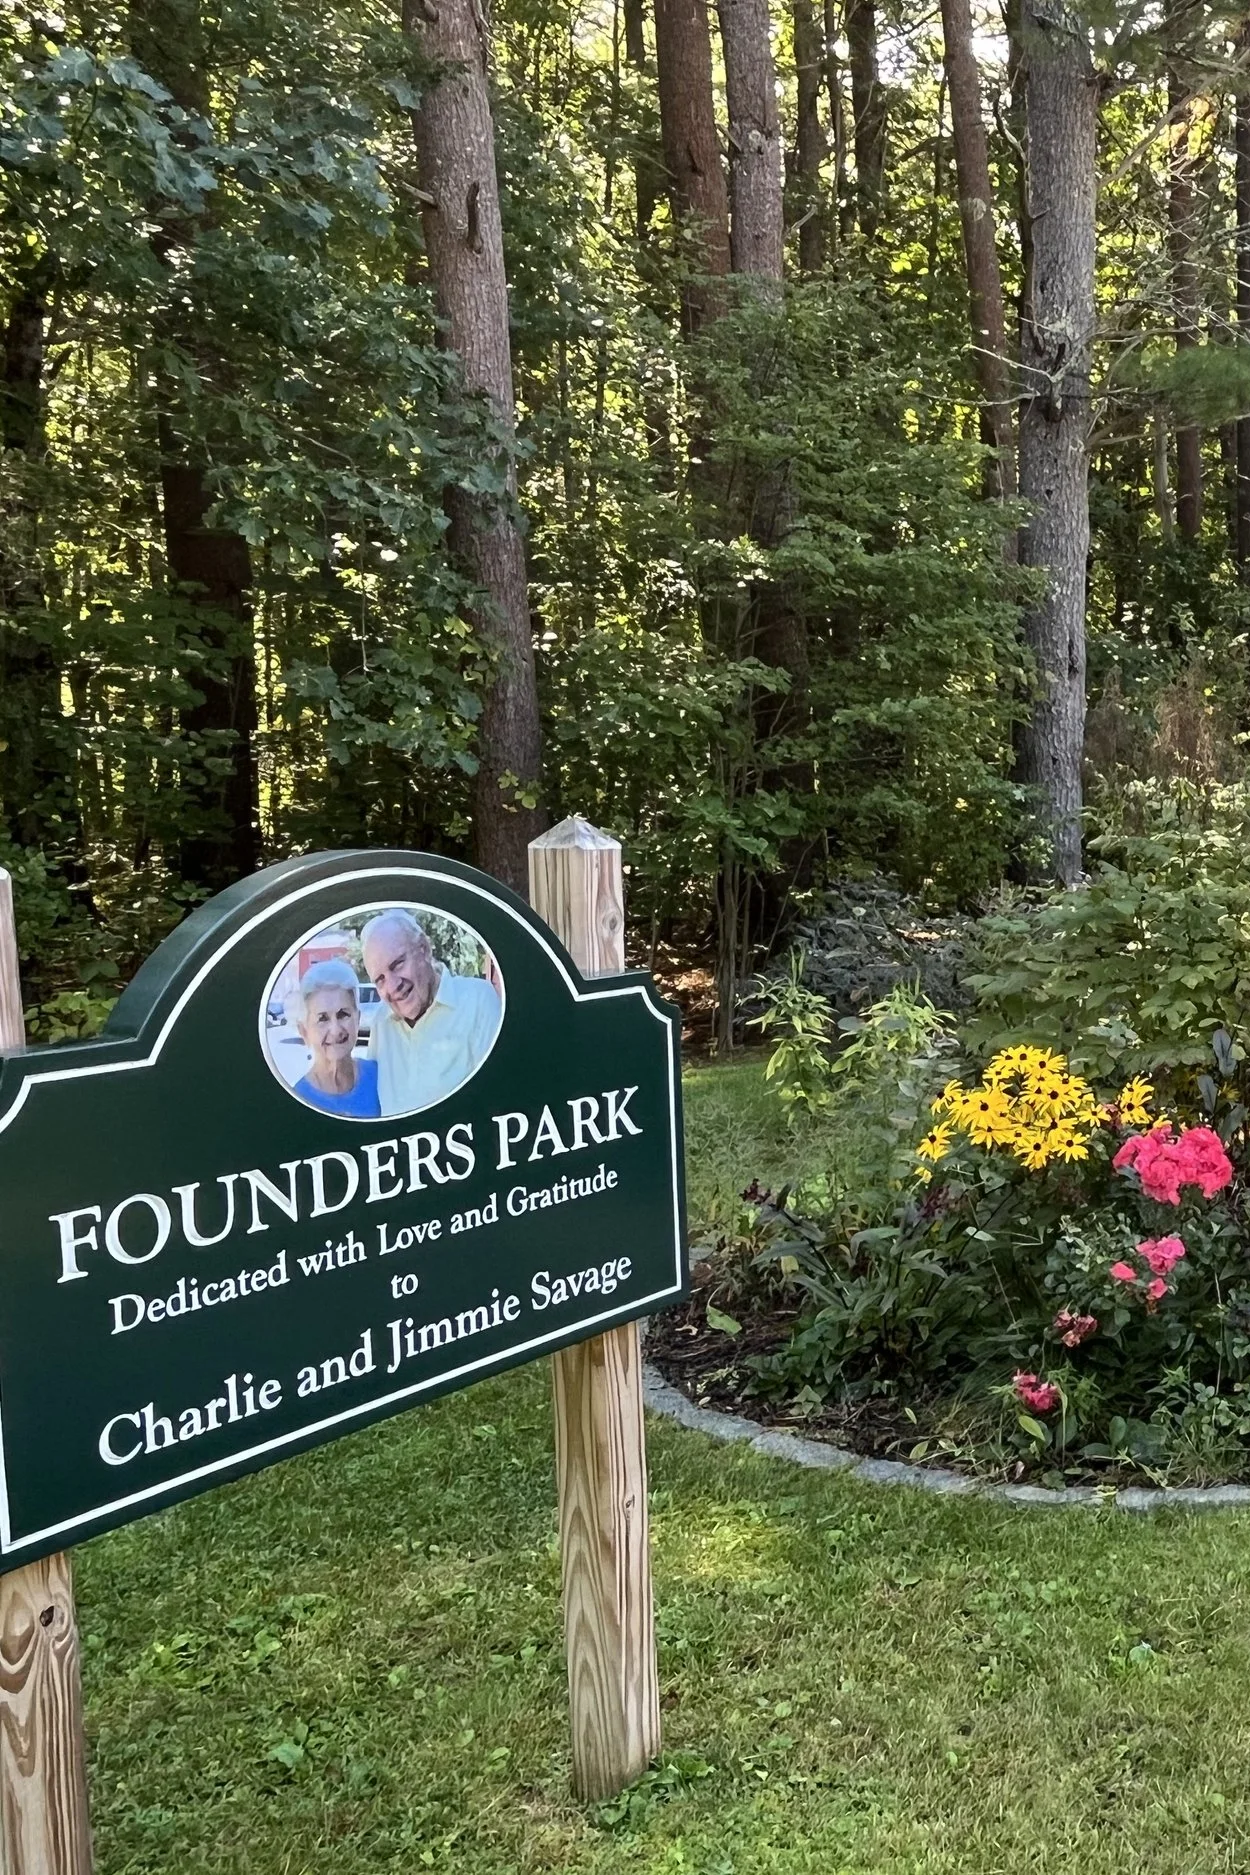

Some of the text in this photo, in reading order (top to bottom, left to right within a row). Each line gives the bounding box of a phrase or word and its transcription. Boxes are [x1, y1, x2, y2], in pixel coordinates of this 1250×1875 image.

[48, 1085, 644, 1284] FOUNDERS PARK
[107, 1163, 619, 1335] Dedicated with Love and Gratitude
[98, 1256, 633, 1467] Charlie and Jimmie Savage
[390, 1273, 419, 1299] to
